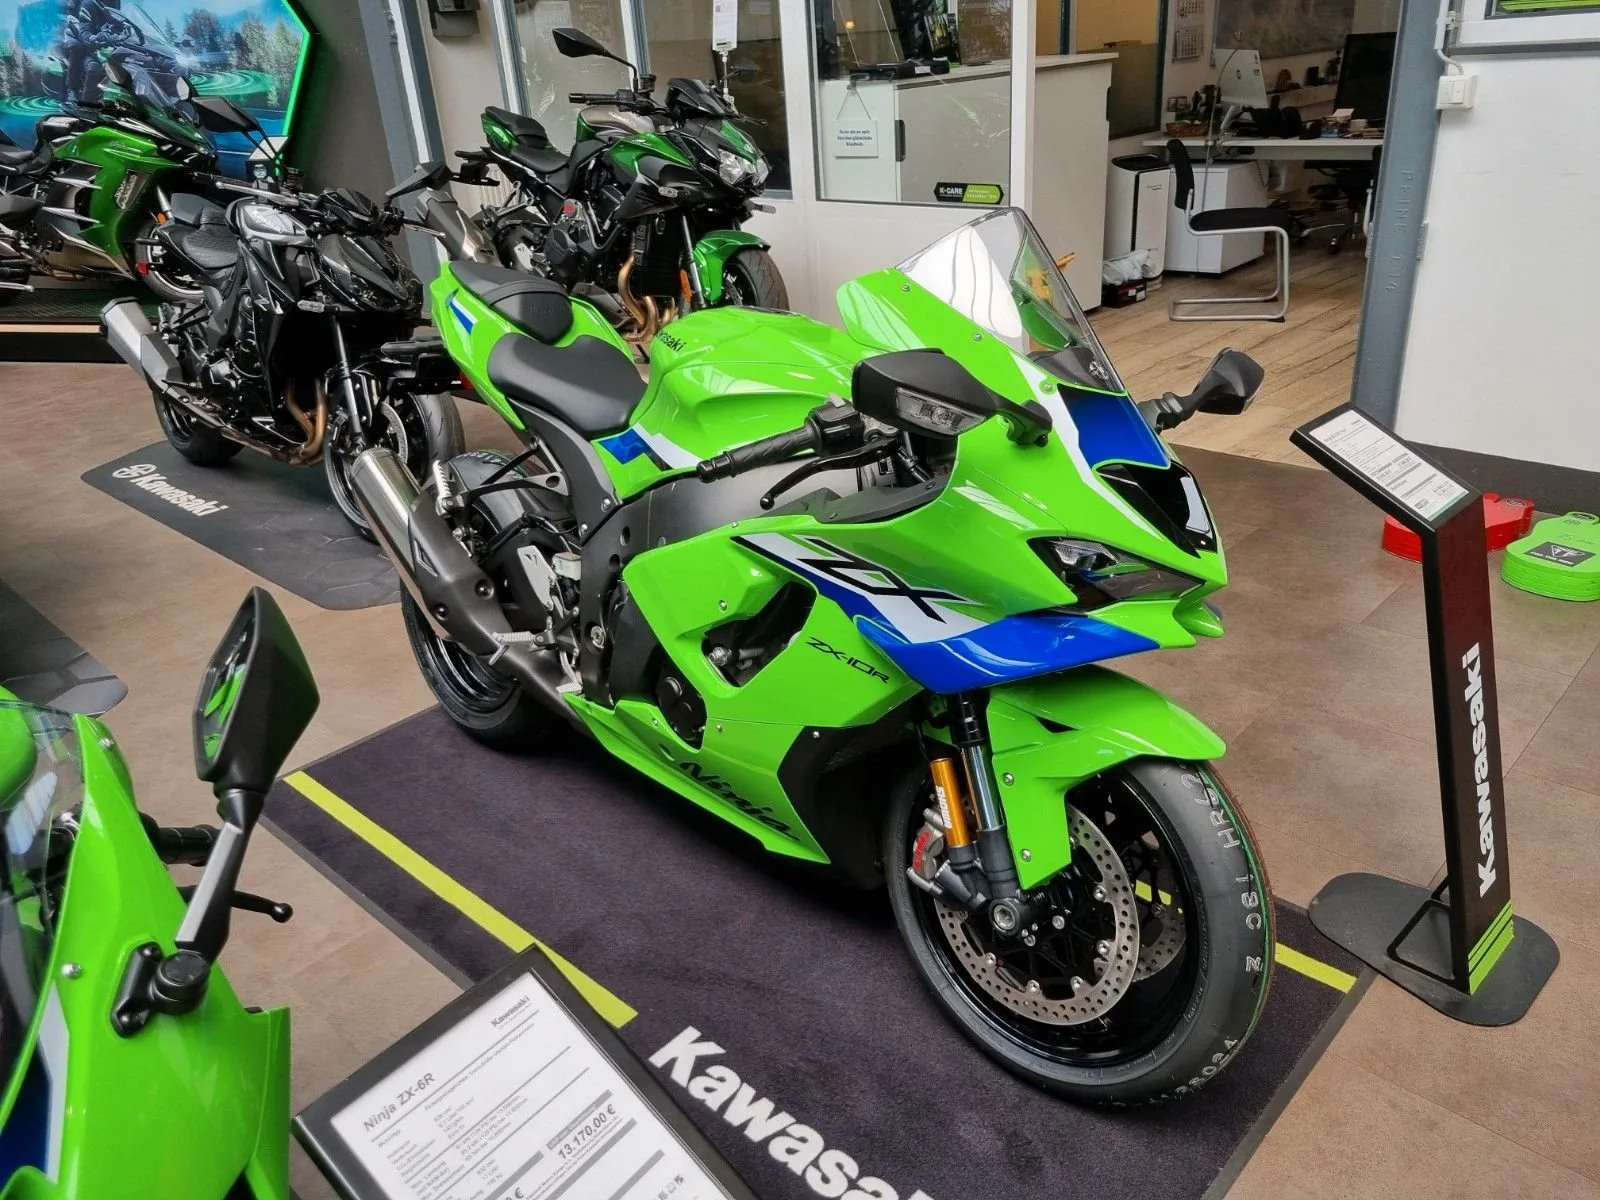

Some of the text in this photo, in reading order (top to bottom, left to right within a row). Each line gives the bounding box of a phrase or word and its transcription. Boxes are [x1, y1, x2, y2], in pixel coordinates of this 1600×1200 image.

[939, 187, 963, 195] K-CARE
[130, 473, 229, 517] Kawasaki
[806, 636, 891, 684] ZX-10R
[1461, 642, 1497, 899] Kawasaki
[492, 995, 530, 1027] Kawasaki
[363, 1072, 435, 1132] Ninja ZX-6R
[558, 1103, 616, 1159] 13.170,00 €
